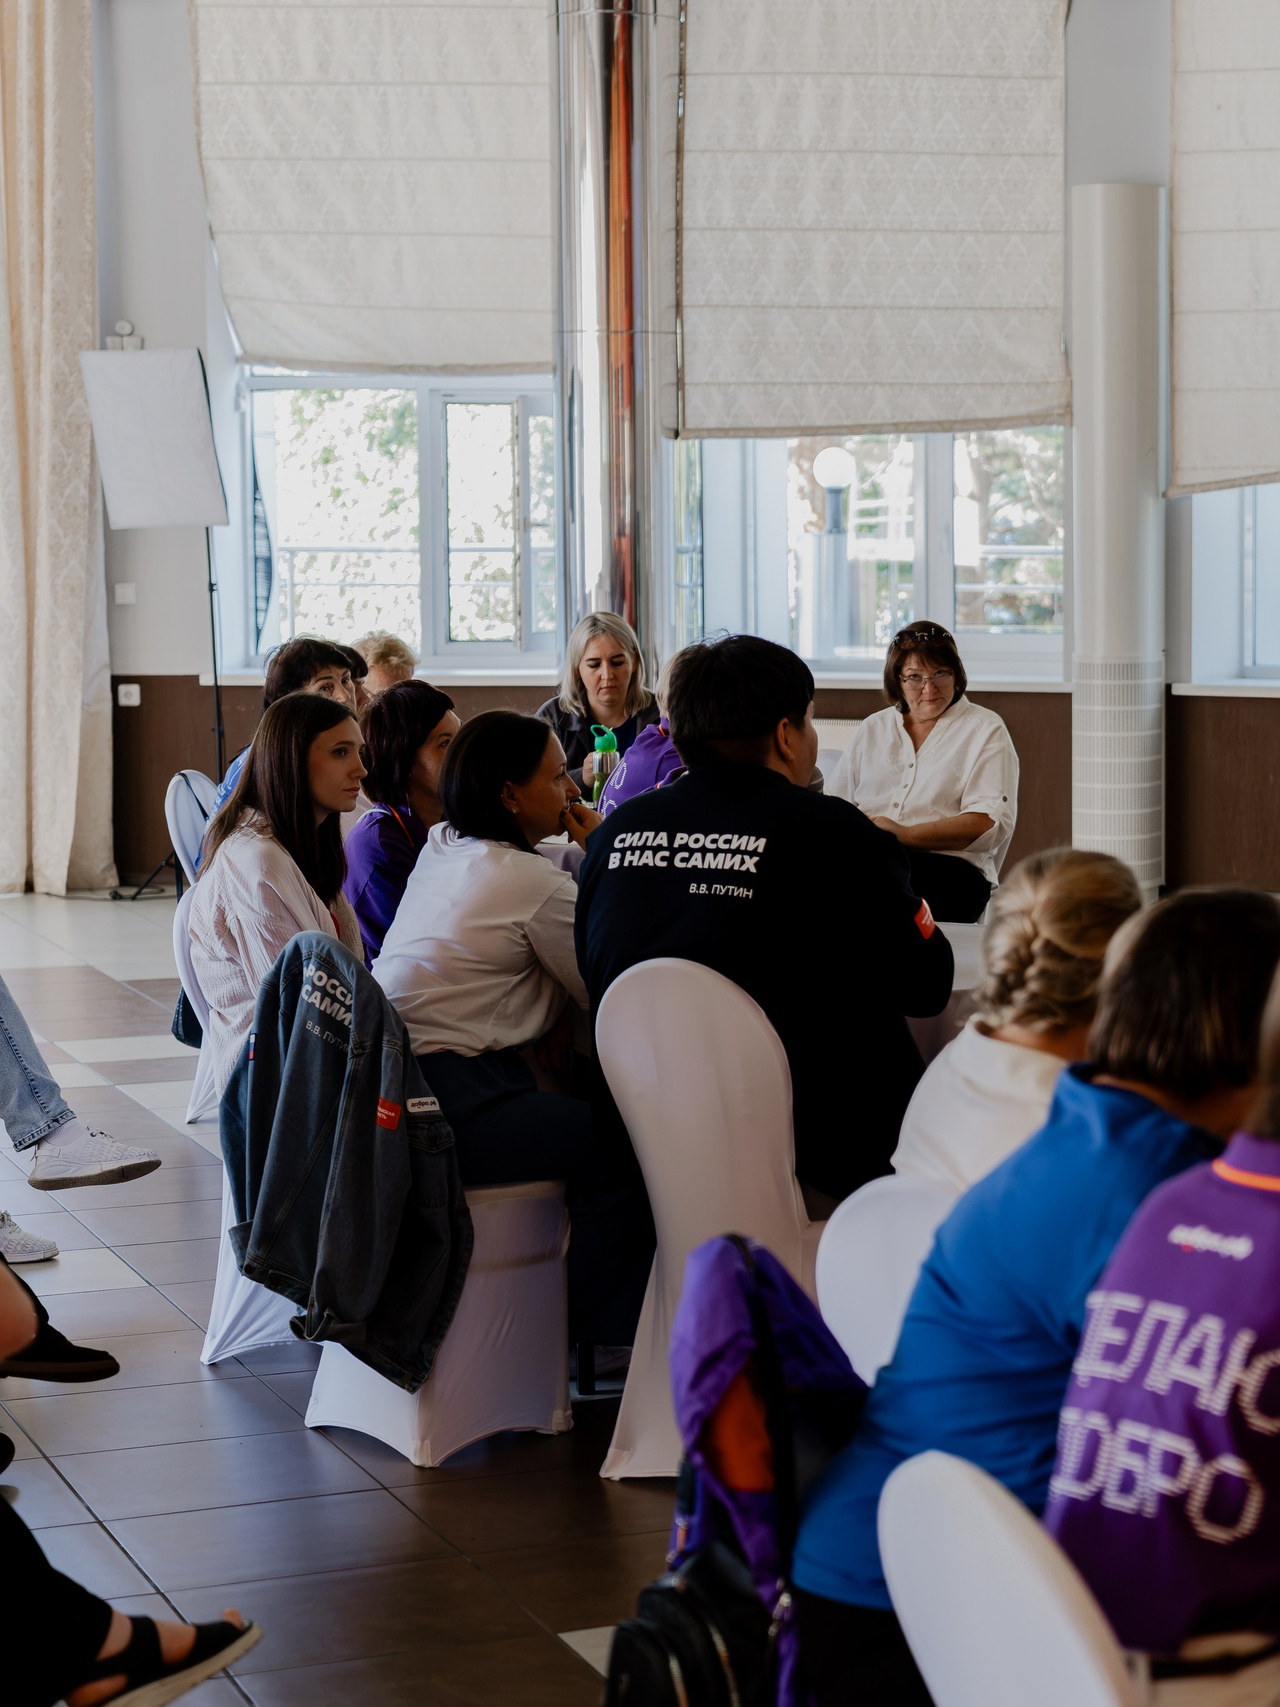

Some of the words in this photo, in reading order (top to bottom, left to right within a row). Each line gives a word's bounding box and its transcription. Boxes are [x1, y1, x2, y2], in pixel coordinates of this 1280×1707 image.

[613, 831, 668, 849] СИЛА
[673, 832, 767, 853] РОССИИ
[608, 852, 622, 870] В
[623, 850, 670, 867] НАС
[673, 852, 760, 873] САМИХ
[689, 883, 709, 894] В.В.
[711, 884, 754, 899] ПУТИН
[301, 984, 353, 1029] САМИ
[305, 1020, 321, 1037] В.В.
